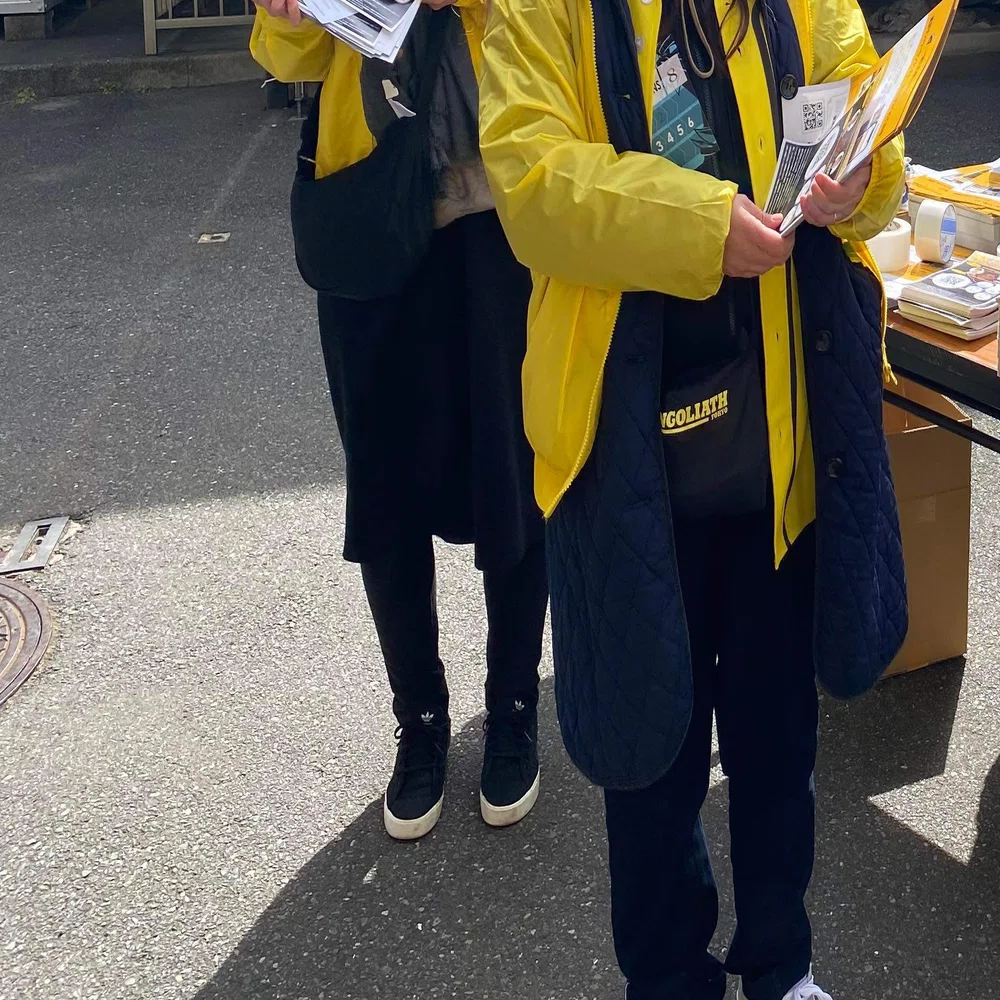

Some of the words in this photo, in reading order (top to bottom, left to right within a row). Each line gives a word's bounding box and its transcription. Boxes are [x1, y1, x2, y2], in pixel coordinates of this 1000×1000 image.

[655, 140, 664, 152] 3
[667, 131, 675, 143] 4
[676, 123, 684, 136] 5
[687, 116, 695, 128] 6
